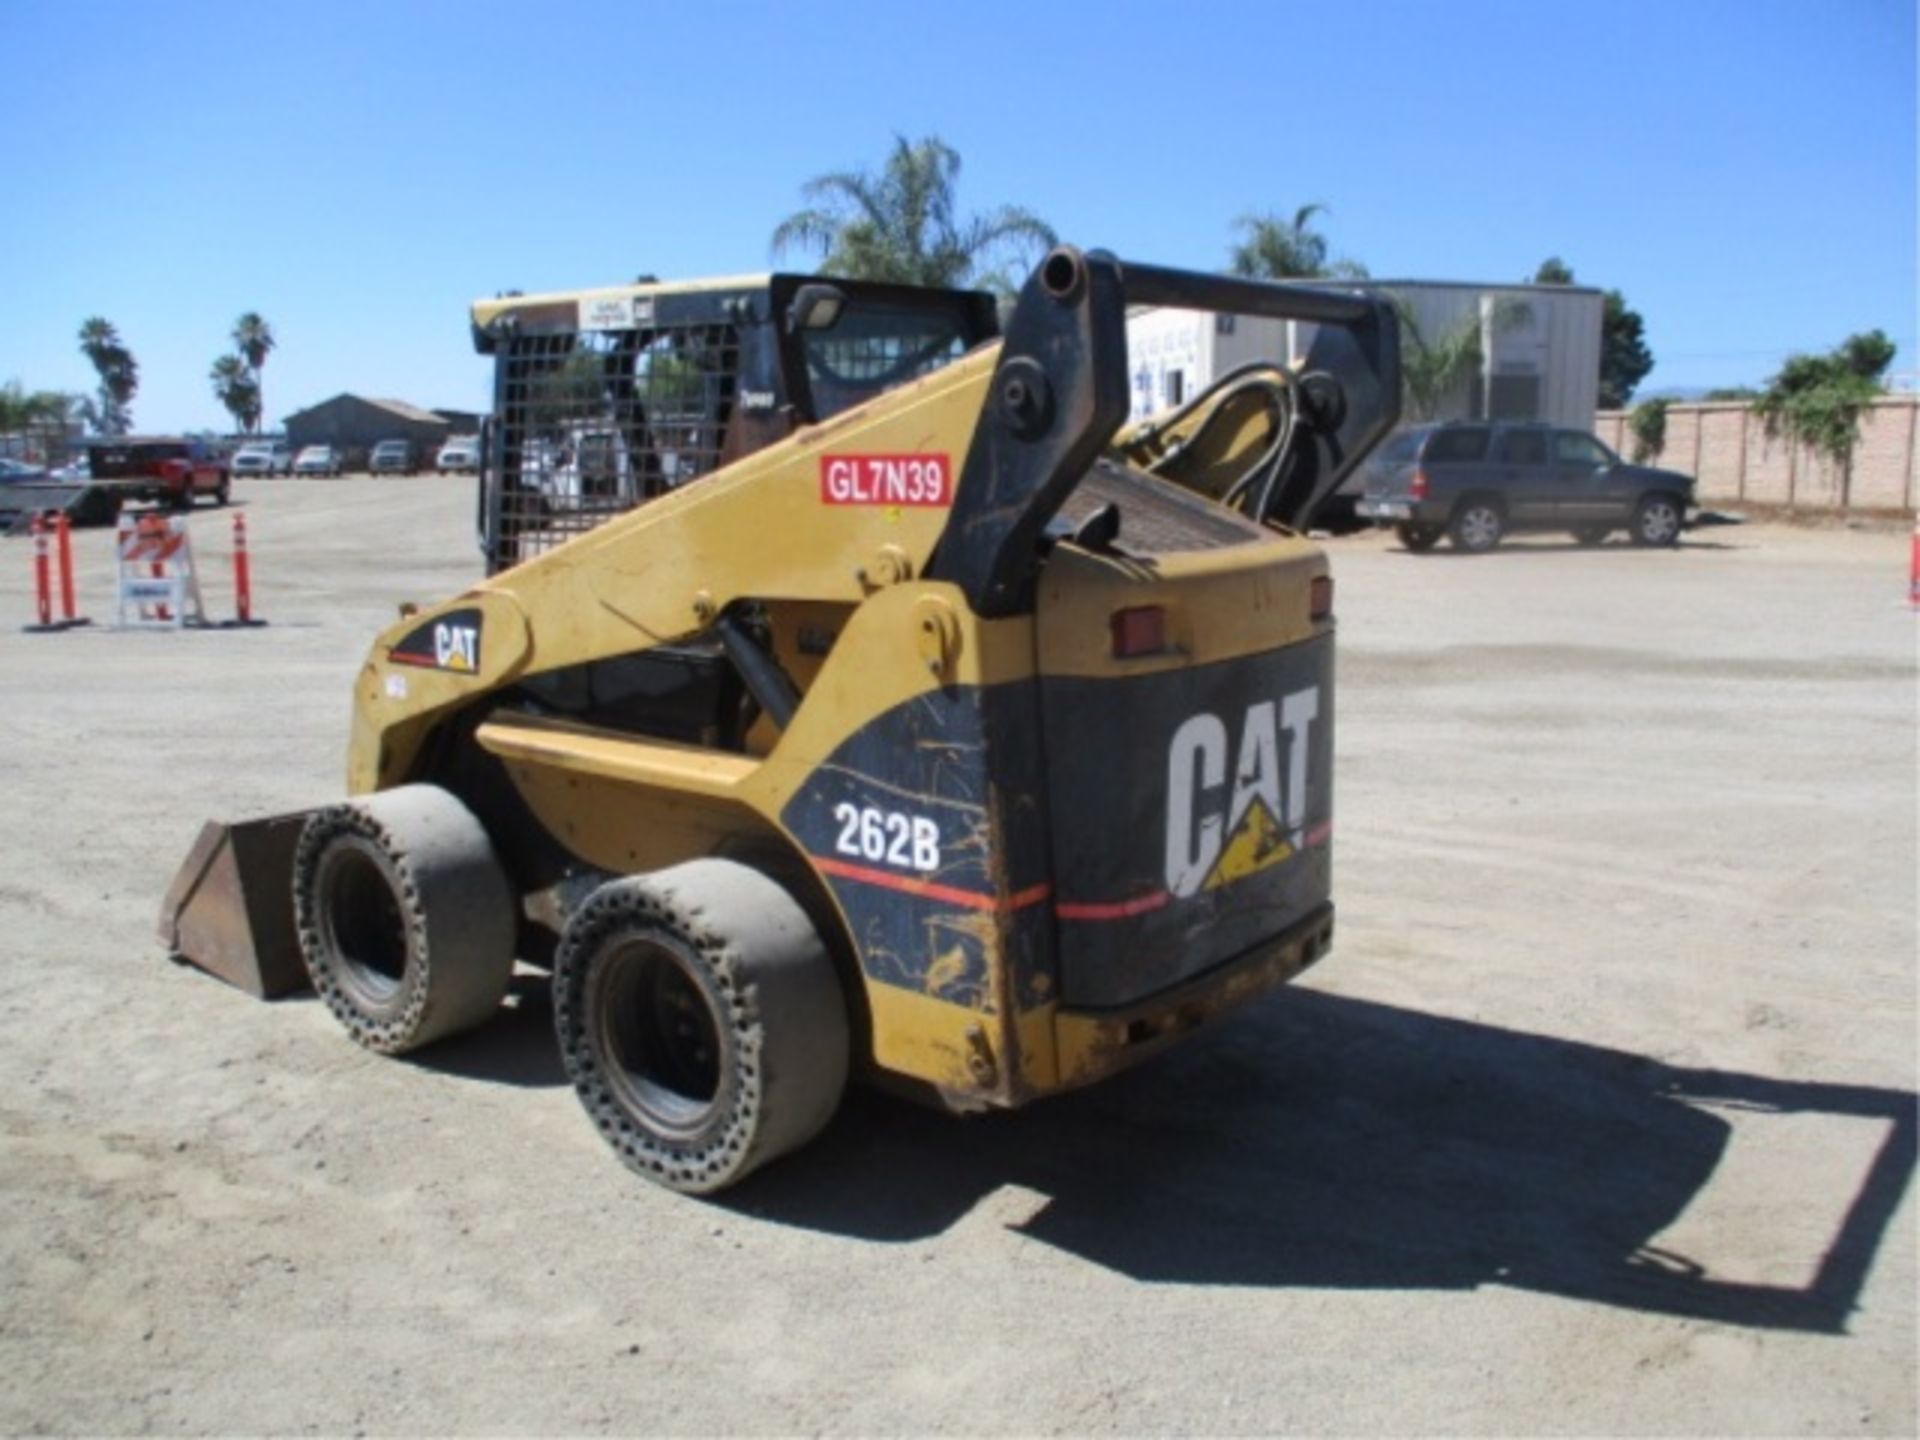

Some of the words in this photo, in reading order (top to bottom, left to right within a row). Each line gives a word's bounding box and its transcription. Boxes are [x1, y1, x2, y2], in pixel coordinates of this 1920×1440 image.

[828, 460, 943, 502] GL7N39
[434, 622, 477, 671] CAT
[1165, 686, 1320, 898] CAT
[834, 802, 940, 871] 262B
